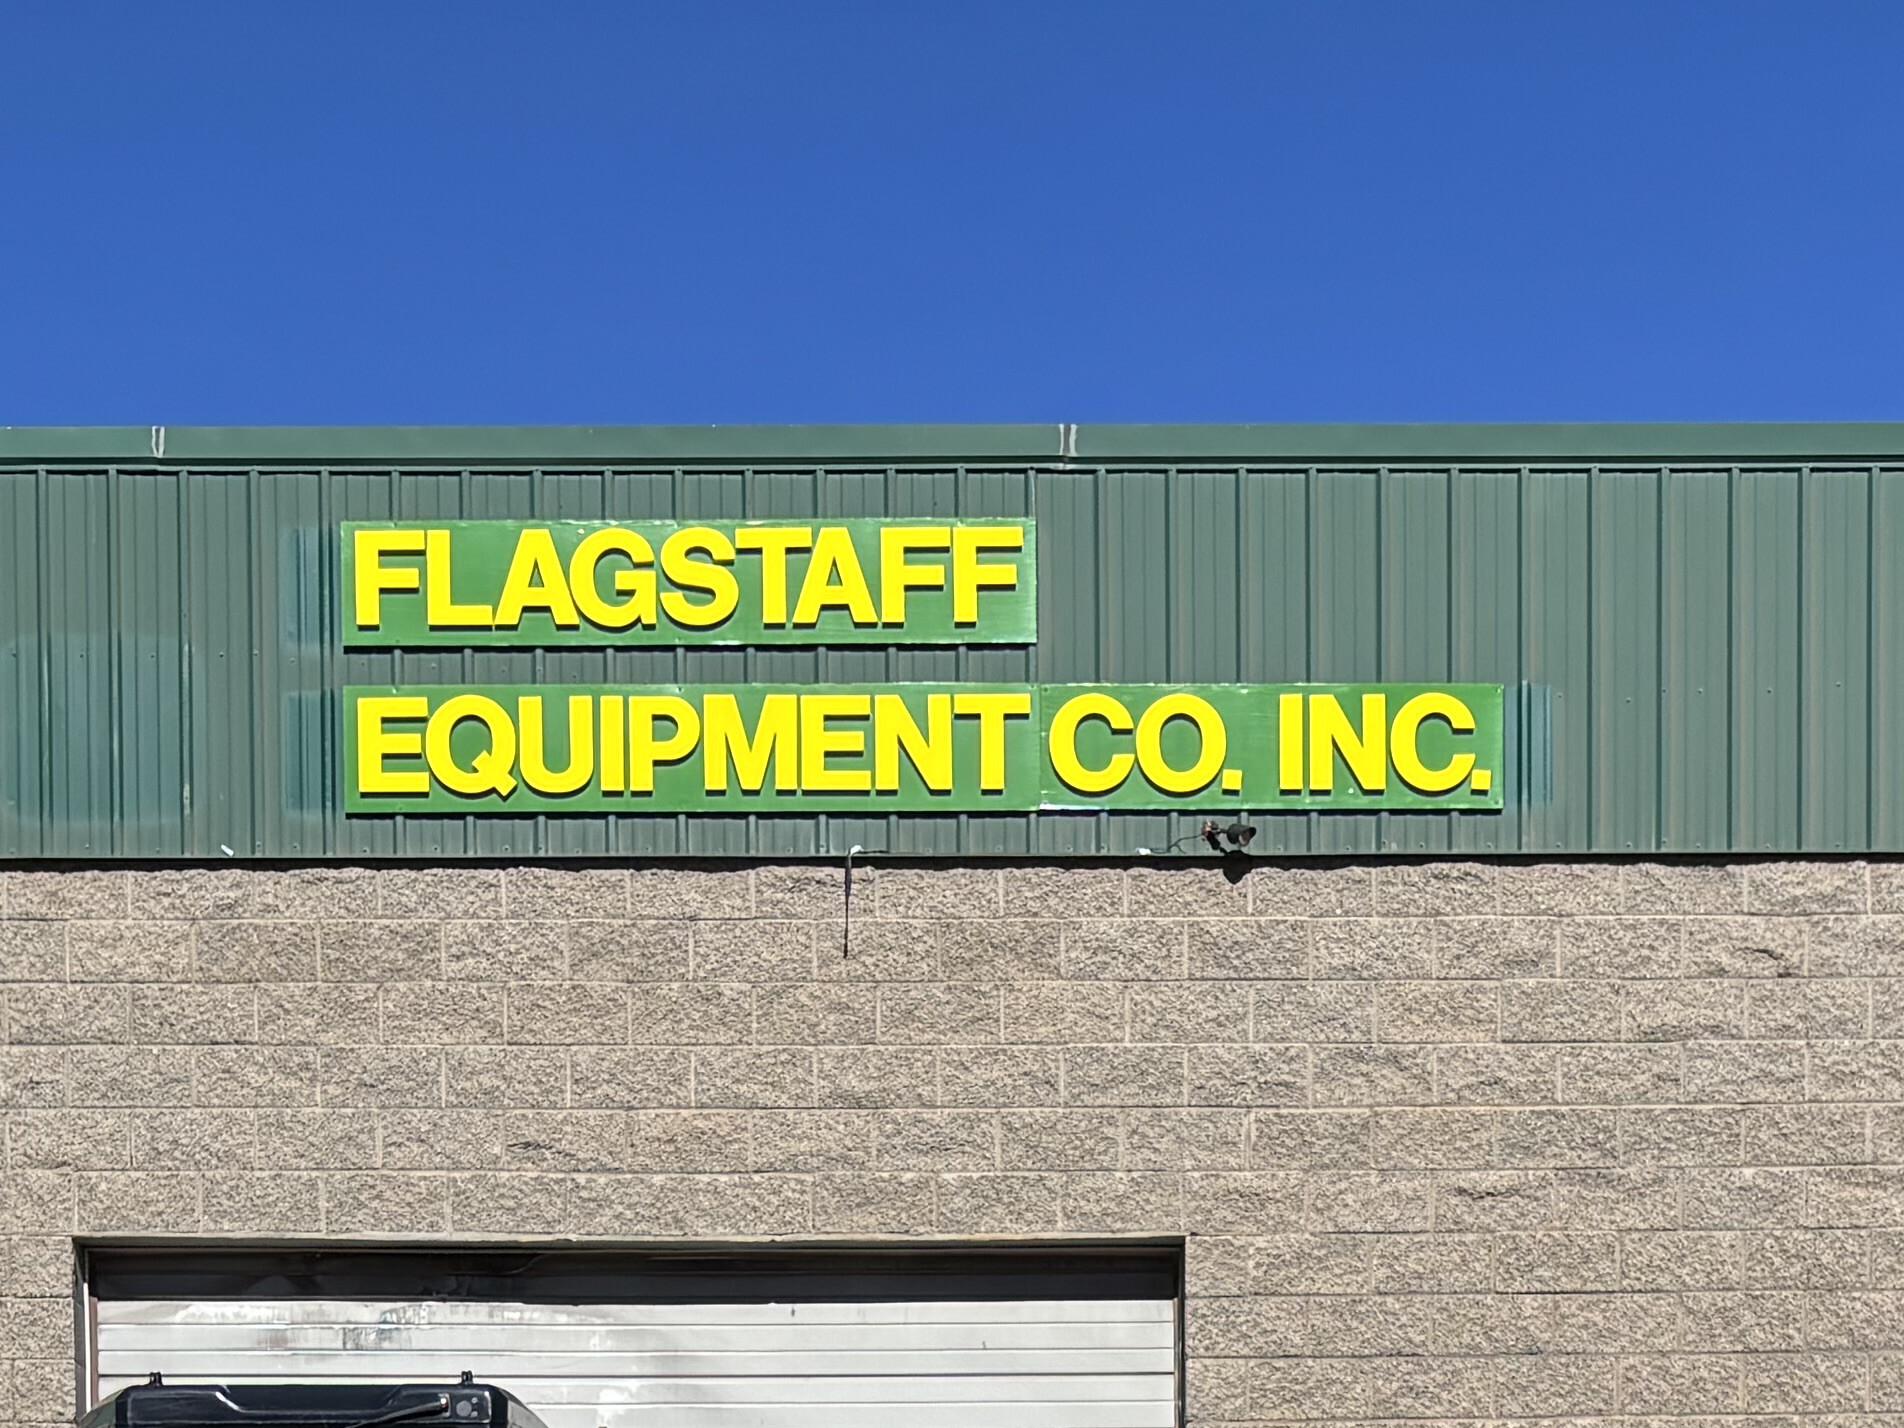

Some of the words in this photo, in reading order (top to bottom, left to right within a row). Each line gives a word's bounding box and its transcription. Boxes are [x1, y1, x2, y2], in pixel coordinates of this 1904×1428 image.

[356, 527, 1024, 627] FLAGSTAFF
[358, 693, 1031, 800] EQUIPMENT
[1049, 693, 1243, 793] CO.
[1280, 693, 1492, 793] INC.
